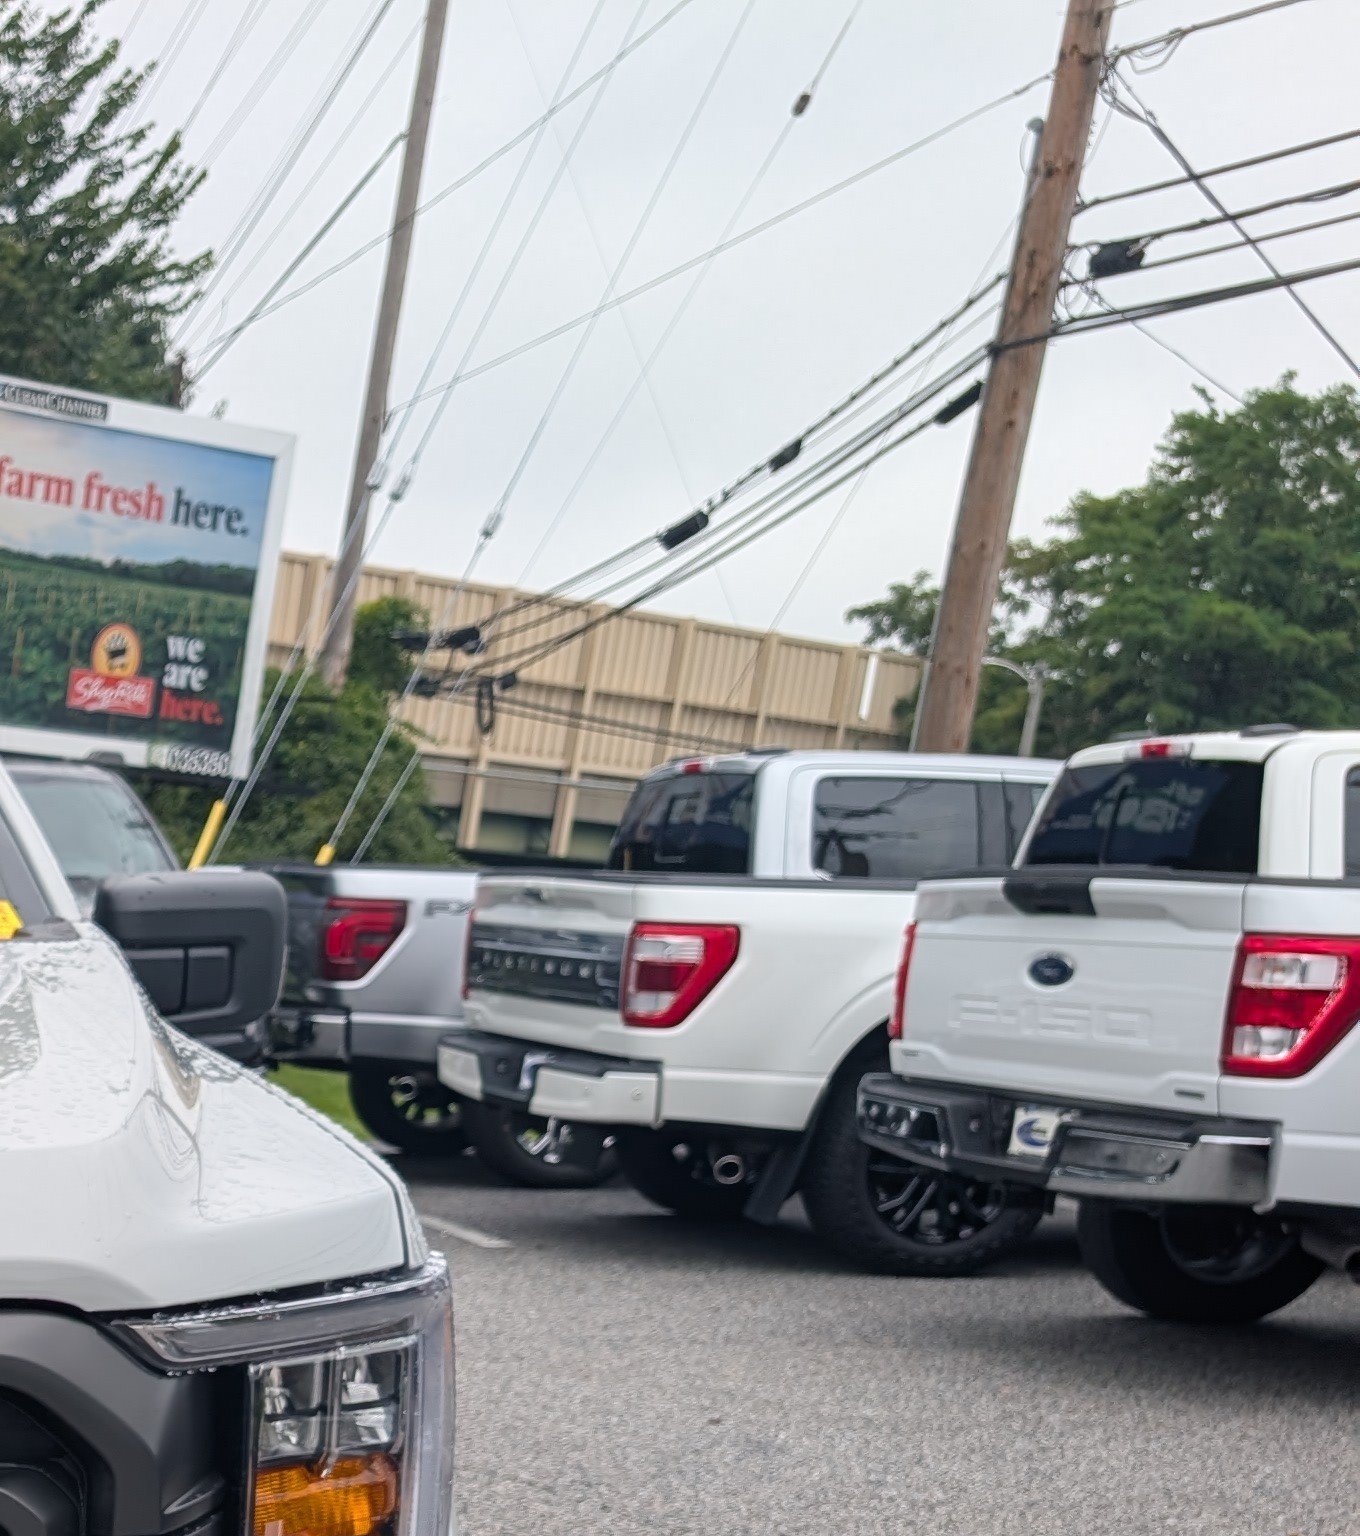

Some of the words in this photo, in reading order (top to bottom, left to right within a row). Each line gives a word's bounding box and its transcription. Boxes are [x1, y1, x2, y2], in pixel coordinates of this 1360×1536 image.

[81, 471, 165, 523] fresh
[170, 486, 249, 537] here.
[166, 635, 206, 664] we
[162, 661, 209, 692] are
[160, 690, 223, 725] here.
